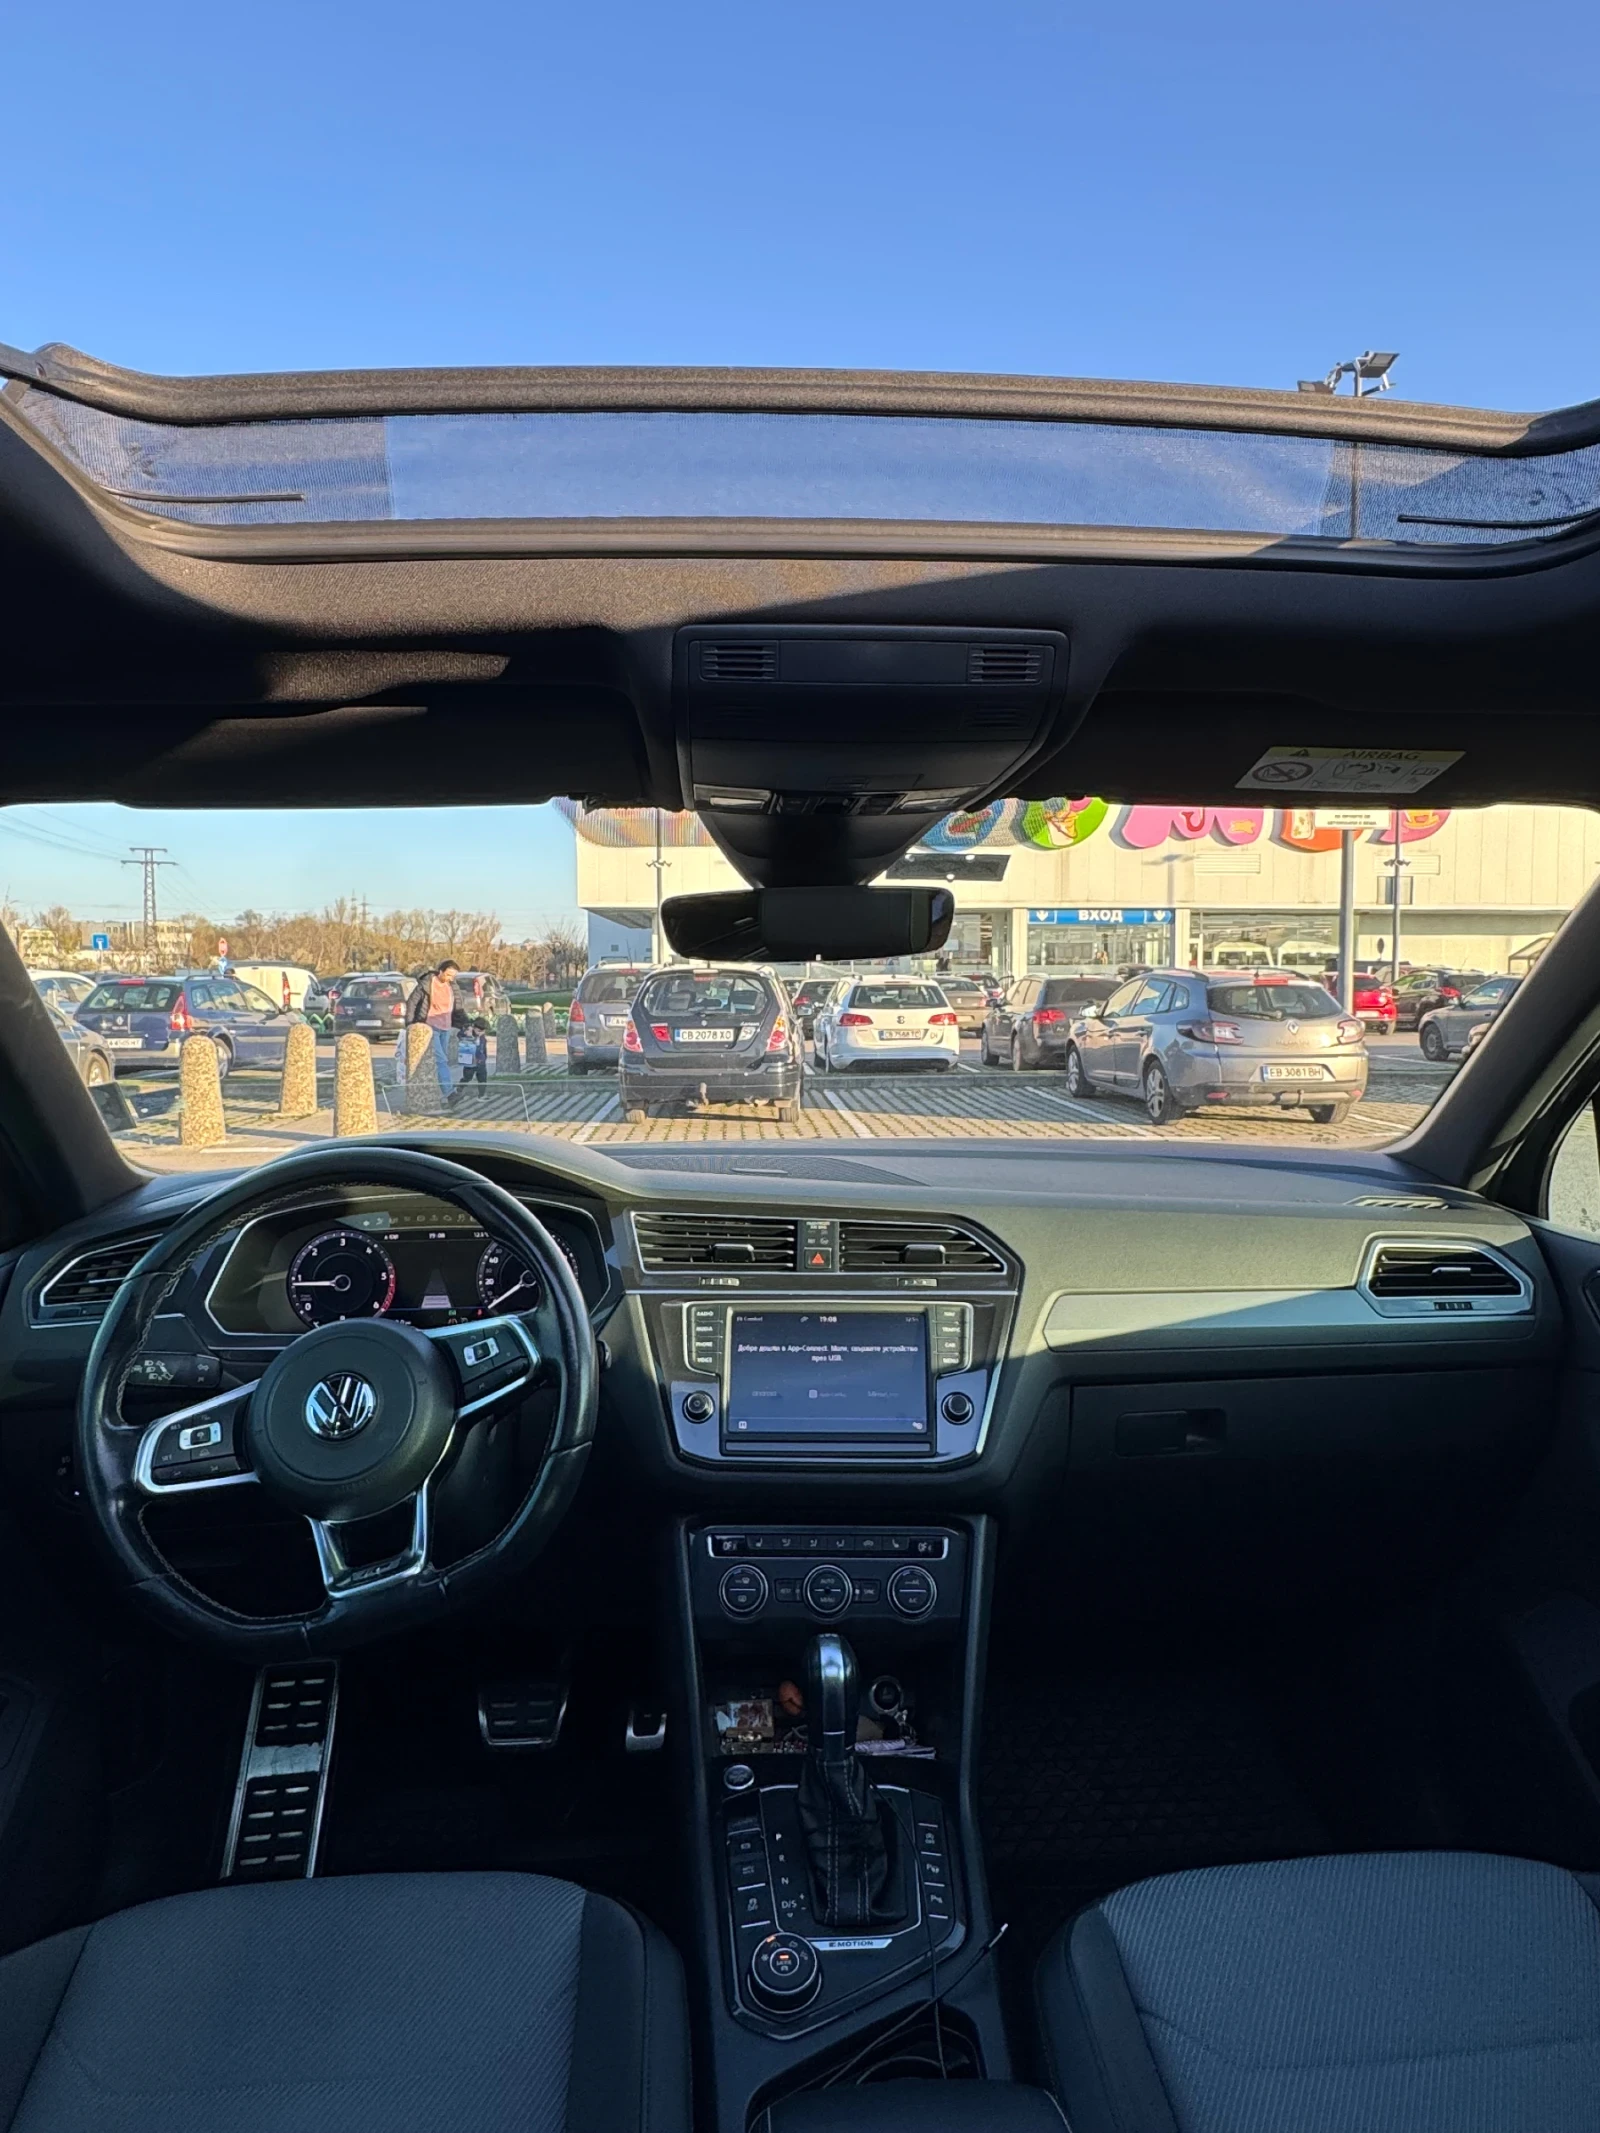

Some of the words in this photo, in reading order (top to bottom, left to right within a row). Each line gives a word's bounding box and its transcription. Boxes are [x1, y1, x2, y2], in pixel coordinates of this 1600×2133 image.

[1344, 751, 1421, 760] AIRBAG
[1078, 909, 1124, 922] ВХОД
[681, 1028, 694, 1040] CB
[695, 1028, 718, 1040] 2078
[340, 1238, 346, 1246] 3
[312, 1248, 318, 1256] 2
[366, 1246, 372, 1254] 4
[380, 1272, 386, 1280] 5
[304, 1302, 311, 1310] 0
[372, 1301, 379, 1309] 6
[775, 1833, 782, 1841] P
[778, 1854, 786, 1863] R
[781, 1900, 797, 1909] D/S
